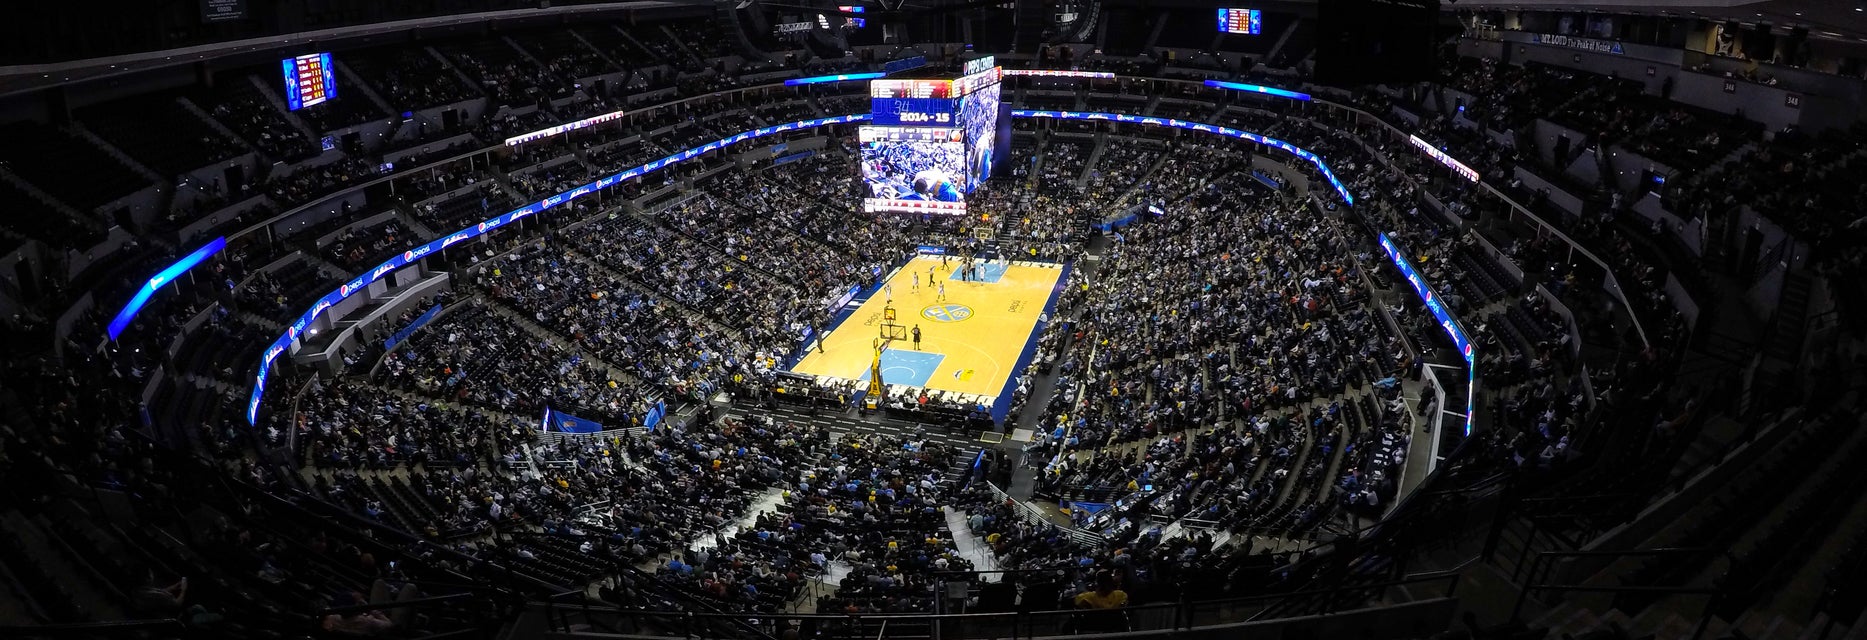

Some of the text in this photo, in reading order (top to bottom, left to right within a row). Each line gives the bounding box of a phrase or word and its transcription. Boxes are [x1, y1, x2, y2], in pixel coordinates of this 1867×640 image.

[1552, 35, 1567, 46] LOUD
[900, 112, 928, 122] 2014
[936, 112, 949, 122] 15
[548, 197, 561, 205] pepsi
[486, 219, 501, 229] pepsi
[413, 246, 430, 257] pepsi
[348, 278, 363, 292] pepsi
[294, 319, 305, 334] pepsi
